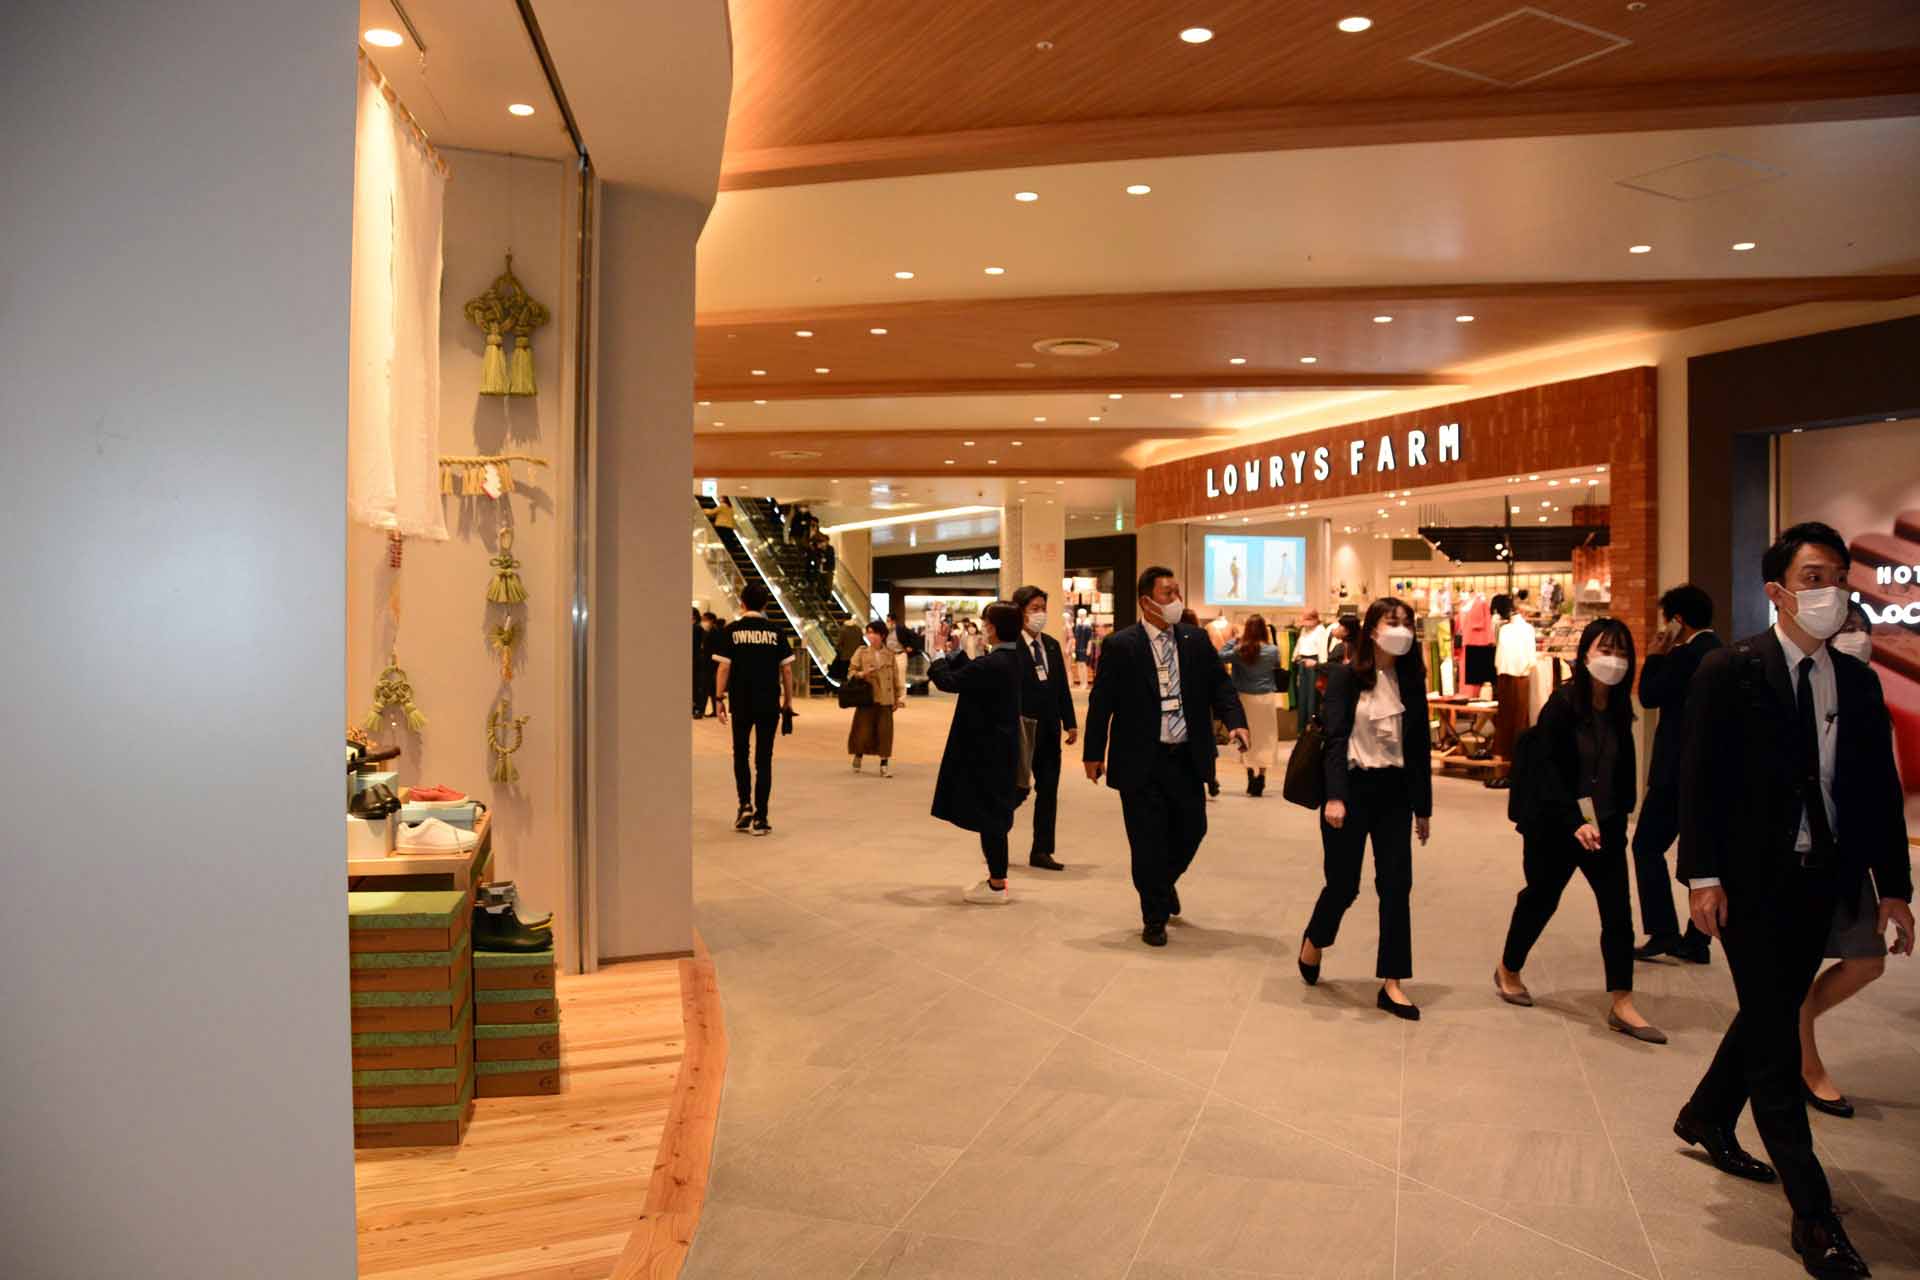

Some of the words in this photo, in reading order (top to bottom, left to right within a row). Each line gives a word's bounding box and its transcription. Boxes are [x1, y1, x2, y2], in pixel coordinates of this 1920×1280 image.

[1206, 446, 1329, 498] LOWRYS
[1350, 423, 1460, 476] FARM
[731, 629, 778, 646] OWNDAYS
